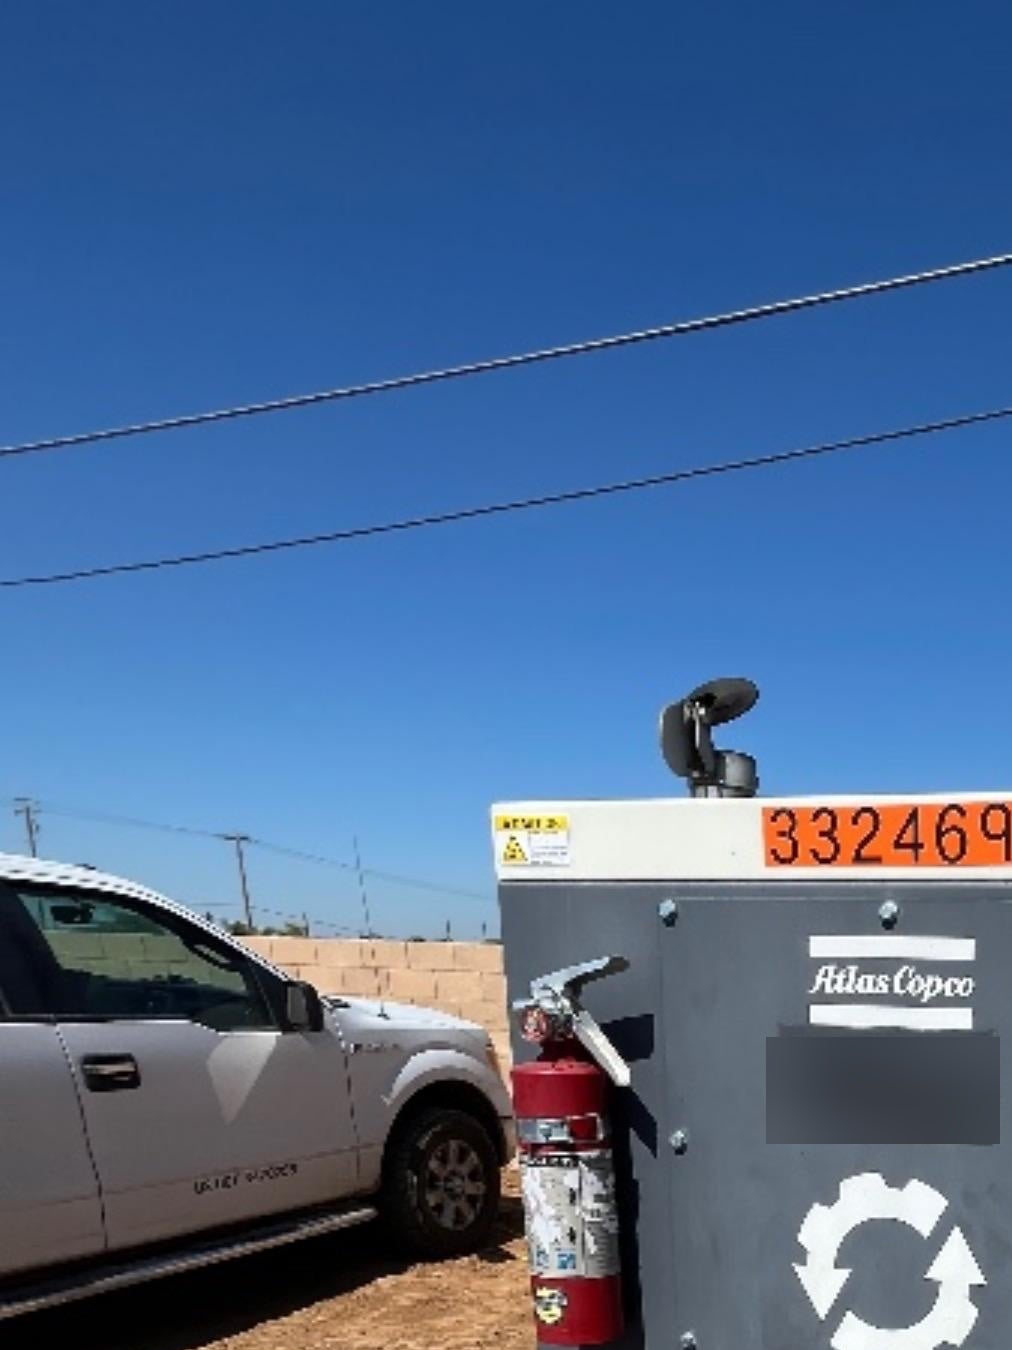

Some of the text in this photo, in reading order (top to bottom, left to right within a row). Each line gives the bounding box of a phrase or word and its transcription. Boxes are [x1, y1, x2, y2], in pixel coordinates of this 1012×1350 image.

[769, 803, 1012, 864] 332469
[808, 965, 975, 1003] Atlas Copco
